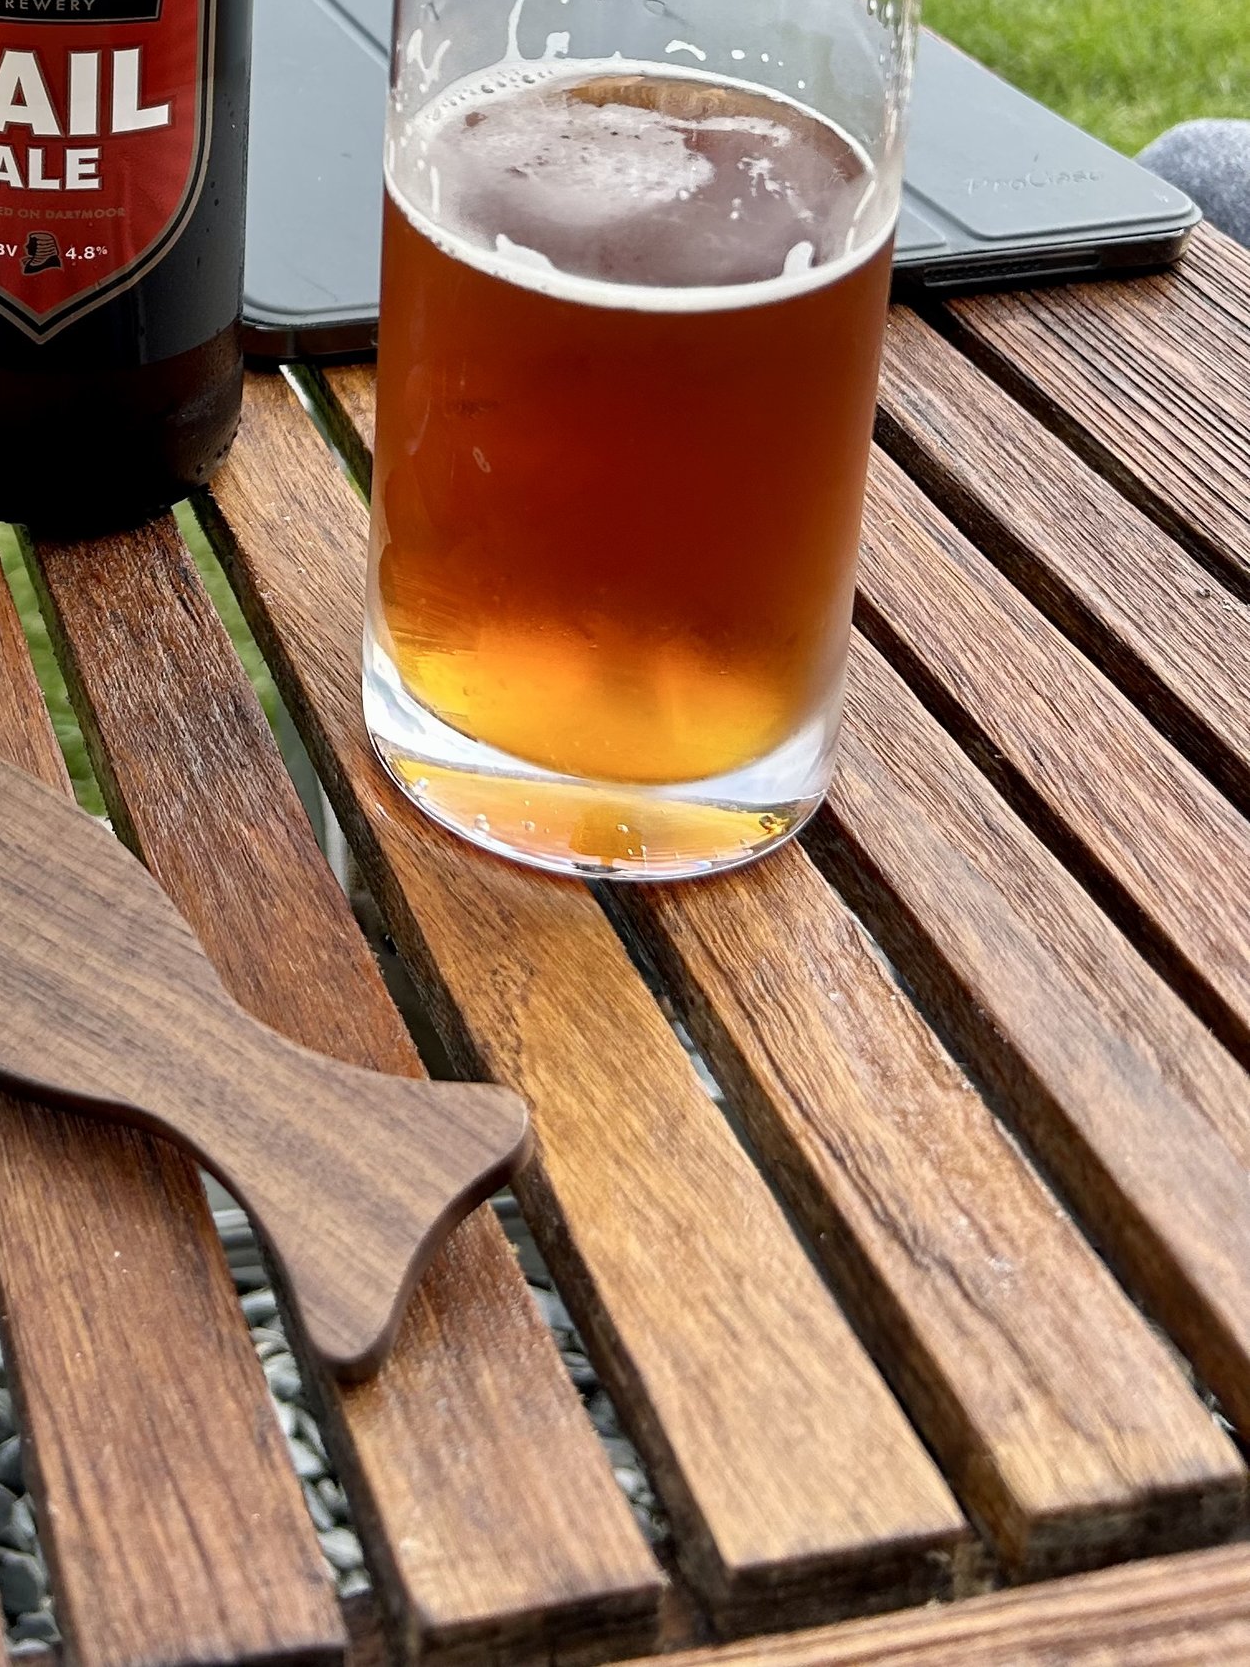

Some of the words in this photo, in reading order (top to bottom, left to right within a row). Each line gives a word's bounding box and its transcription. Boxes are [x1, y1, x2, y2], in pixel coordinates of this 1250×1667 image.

[18, 208, 40, 219] ON
[45, 207, 125, 220] DARTMOOR
[65, 245, 108, 260] 4.8%
